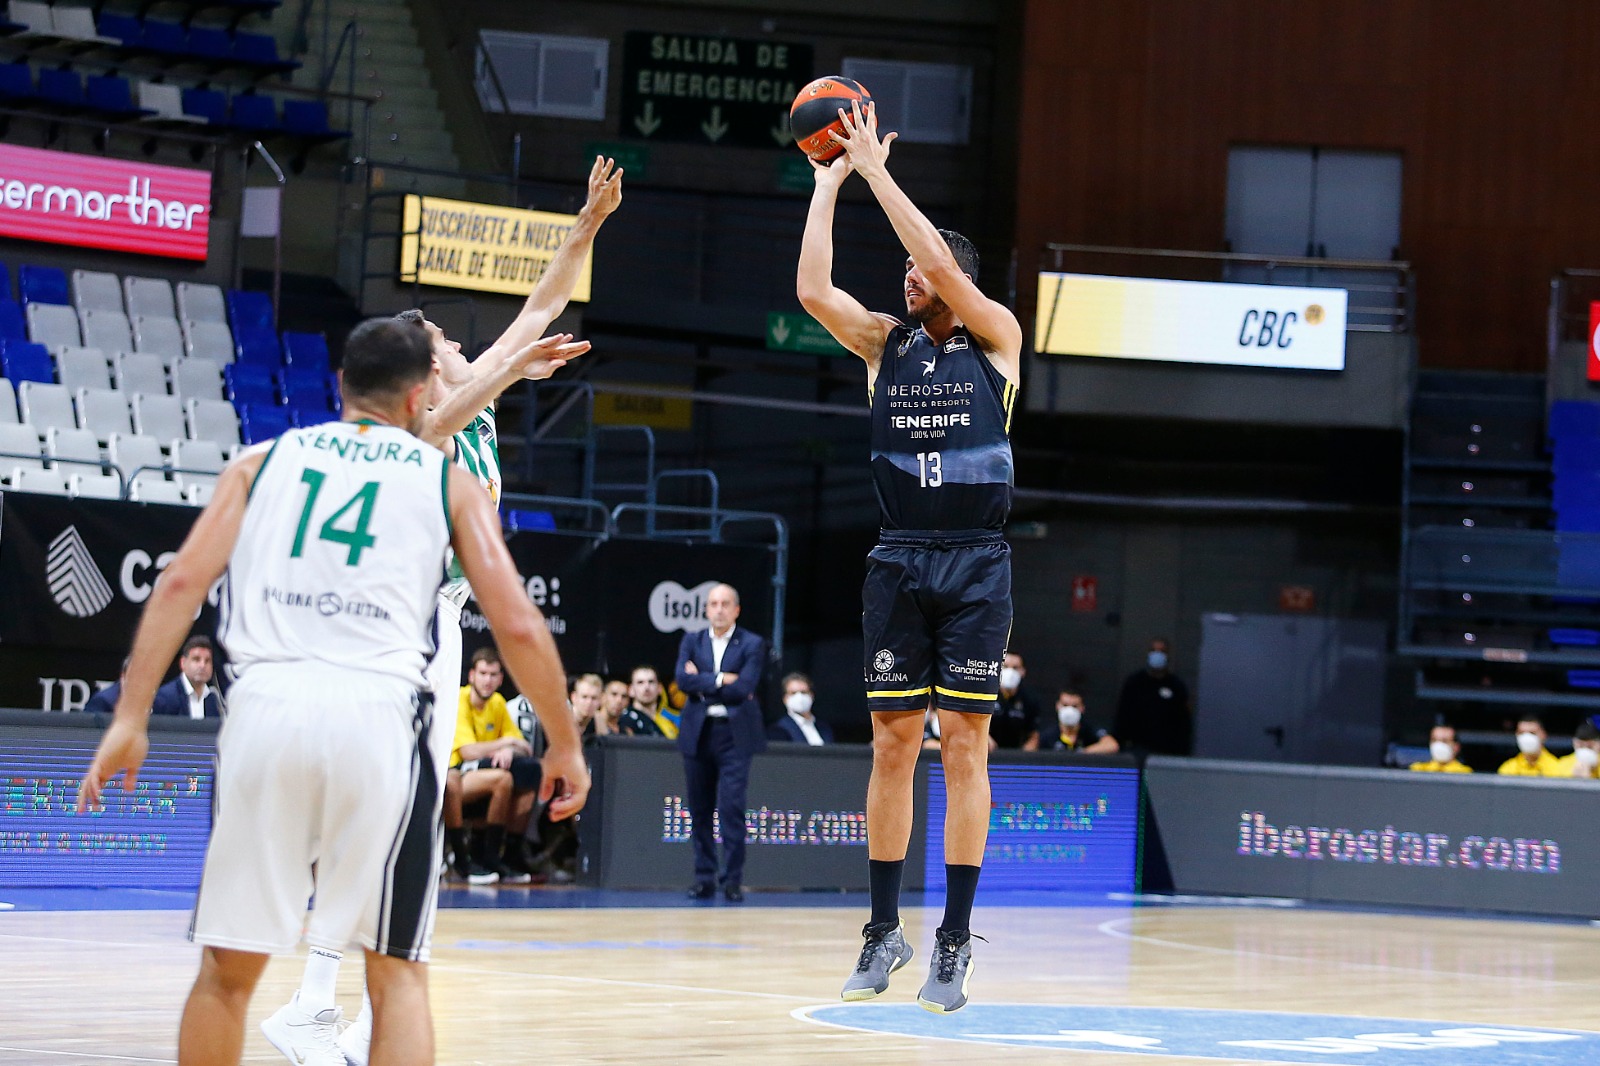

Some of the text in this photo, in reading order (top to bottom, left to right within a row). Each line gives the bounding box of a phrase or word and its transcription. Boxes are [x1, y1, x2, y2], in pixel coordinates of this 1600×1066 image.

[651, 35, 788, 69] SALIDA DE
[638, 69, 798, 105] EMERGENCIA
[0, 175, 205, 232] ermarther
[509, 219, 522, 247] A
[524, 220, 575, 251] NUEST
[420, 244, 550, 285] CANAL DE YOUTUB
[1239, 309, 1297, 348] CBC
[887, 382, 974, 397] IBEROSTAR
[931, 399, 971, 408] RESORTS
[891, 413, 971, 429] TENERIFE
[910, 430, 946, 439] 100% VIDA
[297, 433, 423, 467] VENTURA
[916, 452, 943, 488] 13
[290, 467, 381, 567] 14
[869, 672, 909, 683] LAGUNA
[948, 664, 988, 676] Canarias
[967, 658, 988, 669] Islas
[1238, 809, 1562, 874] iberostar.com
